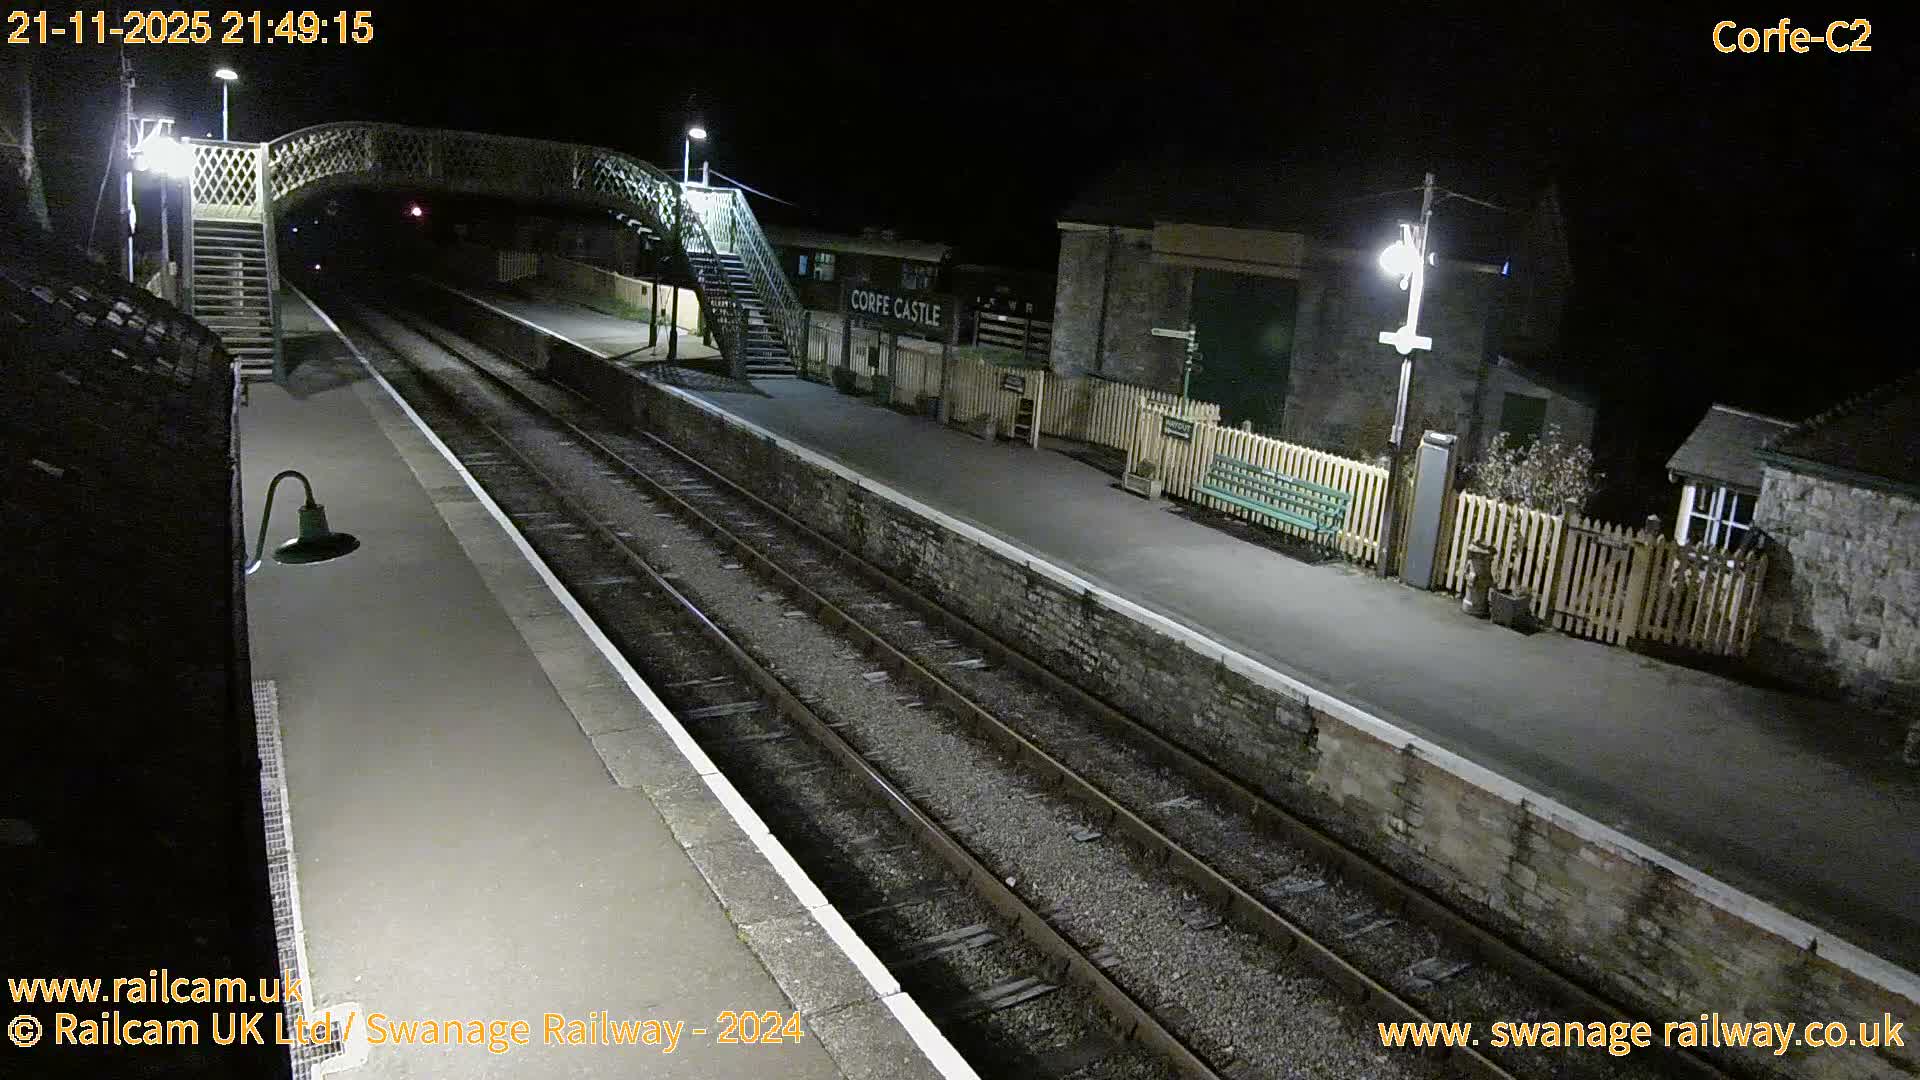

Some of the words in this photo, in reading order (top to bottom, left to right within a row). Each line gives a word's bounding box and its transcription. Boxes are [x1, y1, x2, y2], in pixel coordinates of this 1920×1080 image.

[851, 289, 890, 316] CORFE
[894, 297, 941, 327] CASTLE
[1177, 422, 1191, 433] OUT
